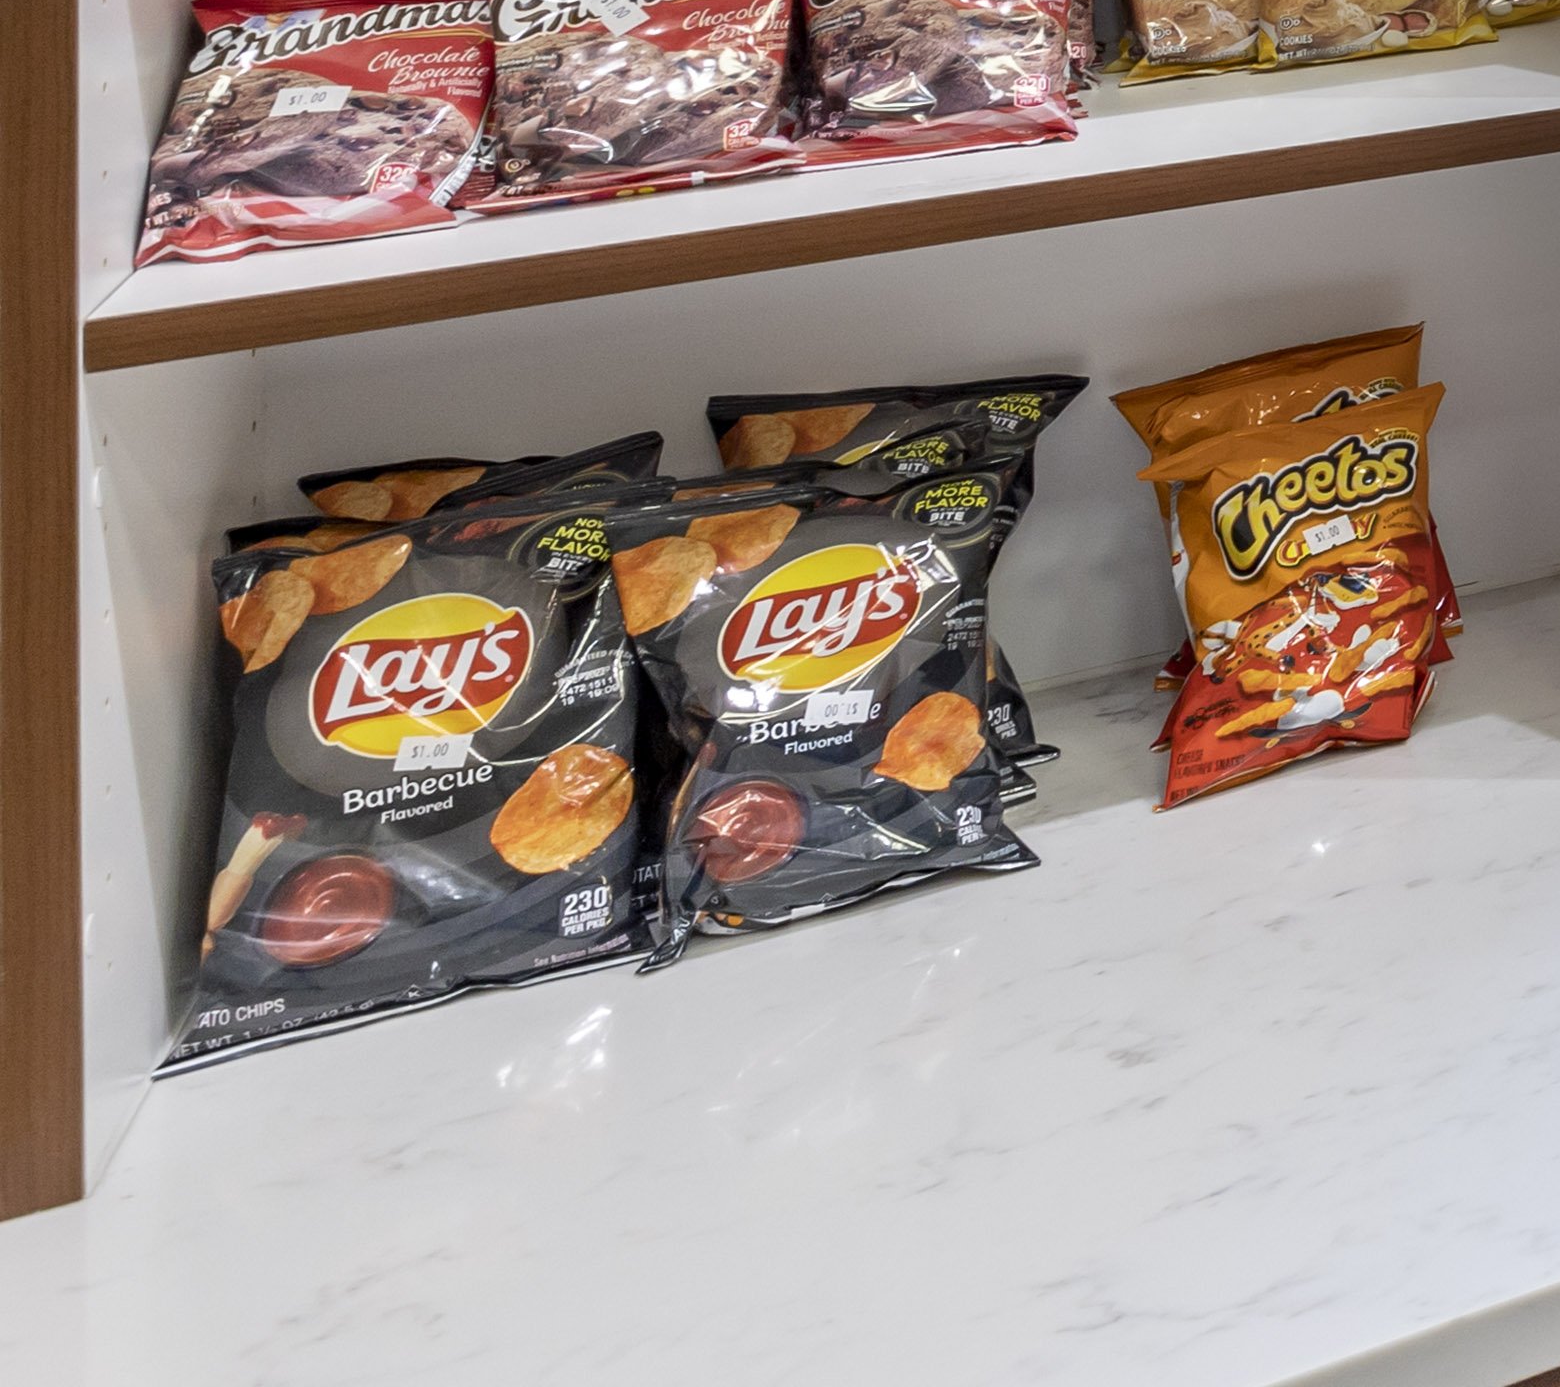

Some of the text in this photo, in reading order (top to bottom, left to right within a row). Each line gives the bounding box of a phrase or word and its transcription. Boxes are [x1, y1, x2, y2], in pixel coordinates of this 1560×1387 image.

[1281, 35, 1313, 46] COOKIES
[368, 46, 481, 73] Chocolate
[389, 64, 490, 85] Brownie
[289, 92, 328, 105] $1.00
[991, 395, 1042, 407] MORE
[977, 400, 1041, 422] FLAVOR
[896, 440, 949, 452] MORE
[883, 449, 945, 465] FLAVOR
[926, 486, 983, 498] MORE
[940, 479, 975, 488] NOW
[915, 496, 989, 513] FLAVOR
[1215, 439, 1414, 575] Cheetos
[930, 512, 965, 522] BITE
[1315, 524, 1341, 541] $1.00
[733, 567, 906, 663] Lay's
[324, 620, 521, 725] Lay's
[411, 741, 449, 758] $1.00
[784, 732, 853, 754] Flavored
[342, 762, 494, 815] Barbecue
[380, 796, 454, 826] Flavored
[562, 891, 607, 911] 230
[561, 908, 609, 927] CALORIES
[564, 923, 584, 936] PER
[235, 998, 285, 1022] CHIPS
